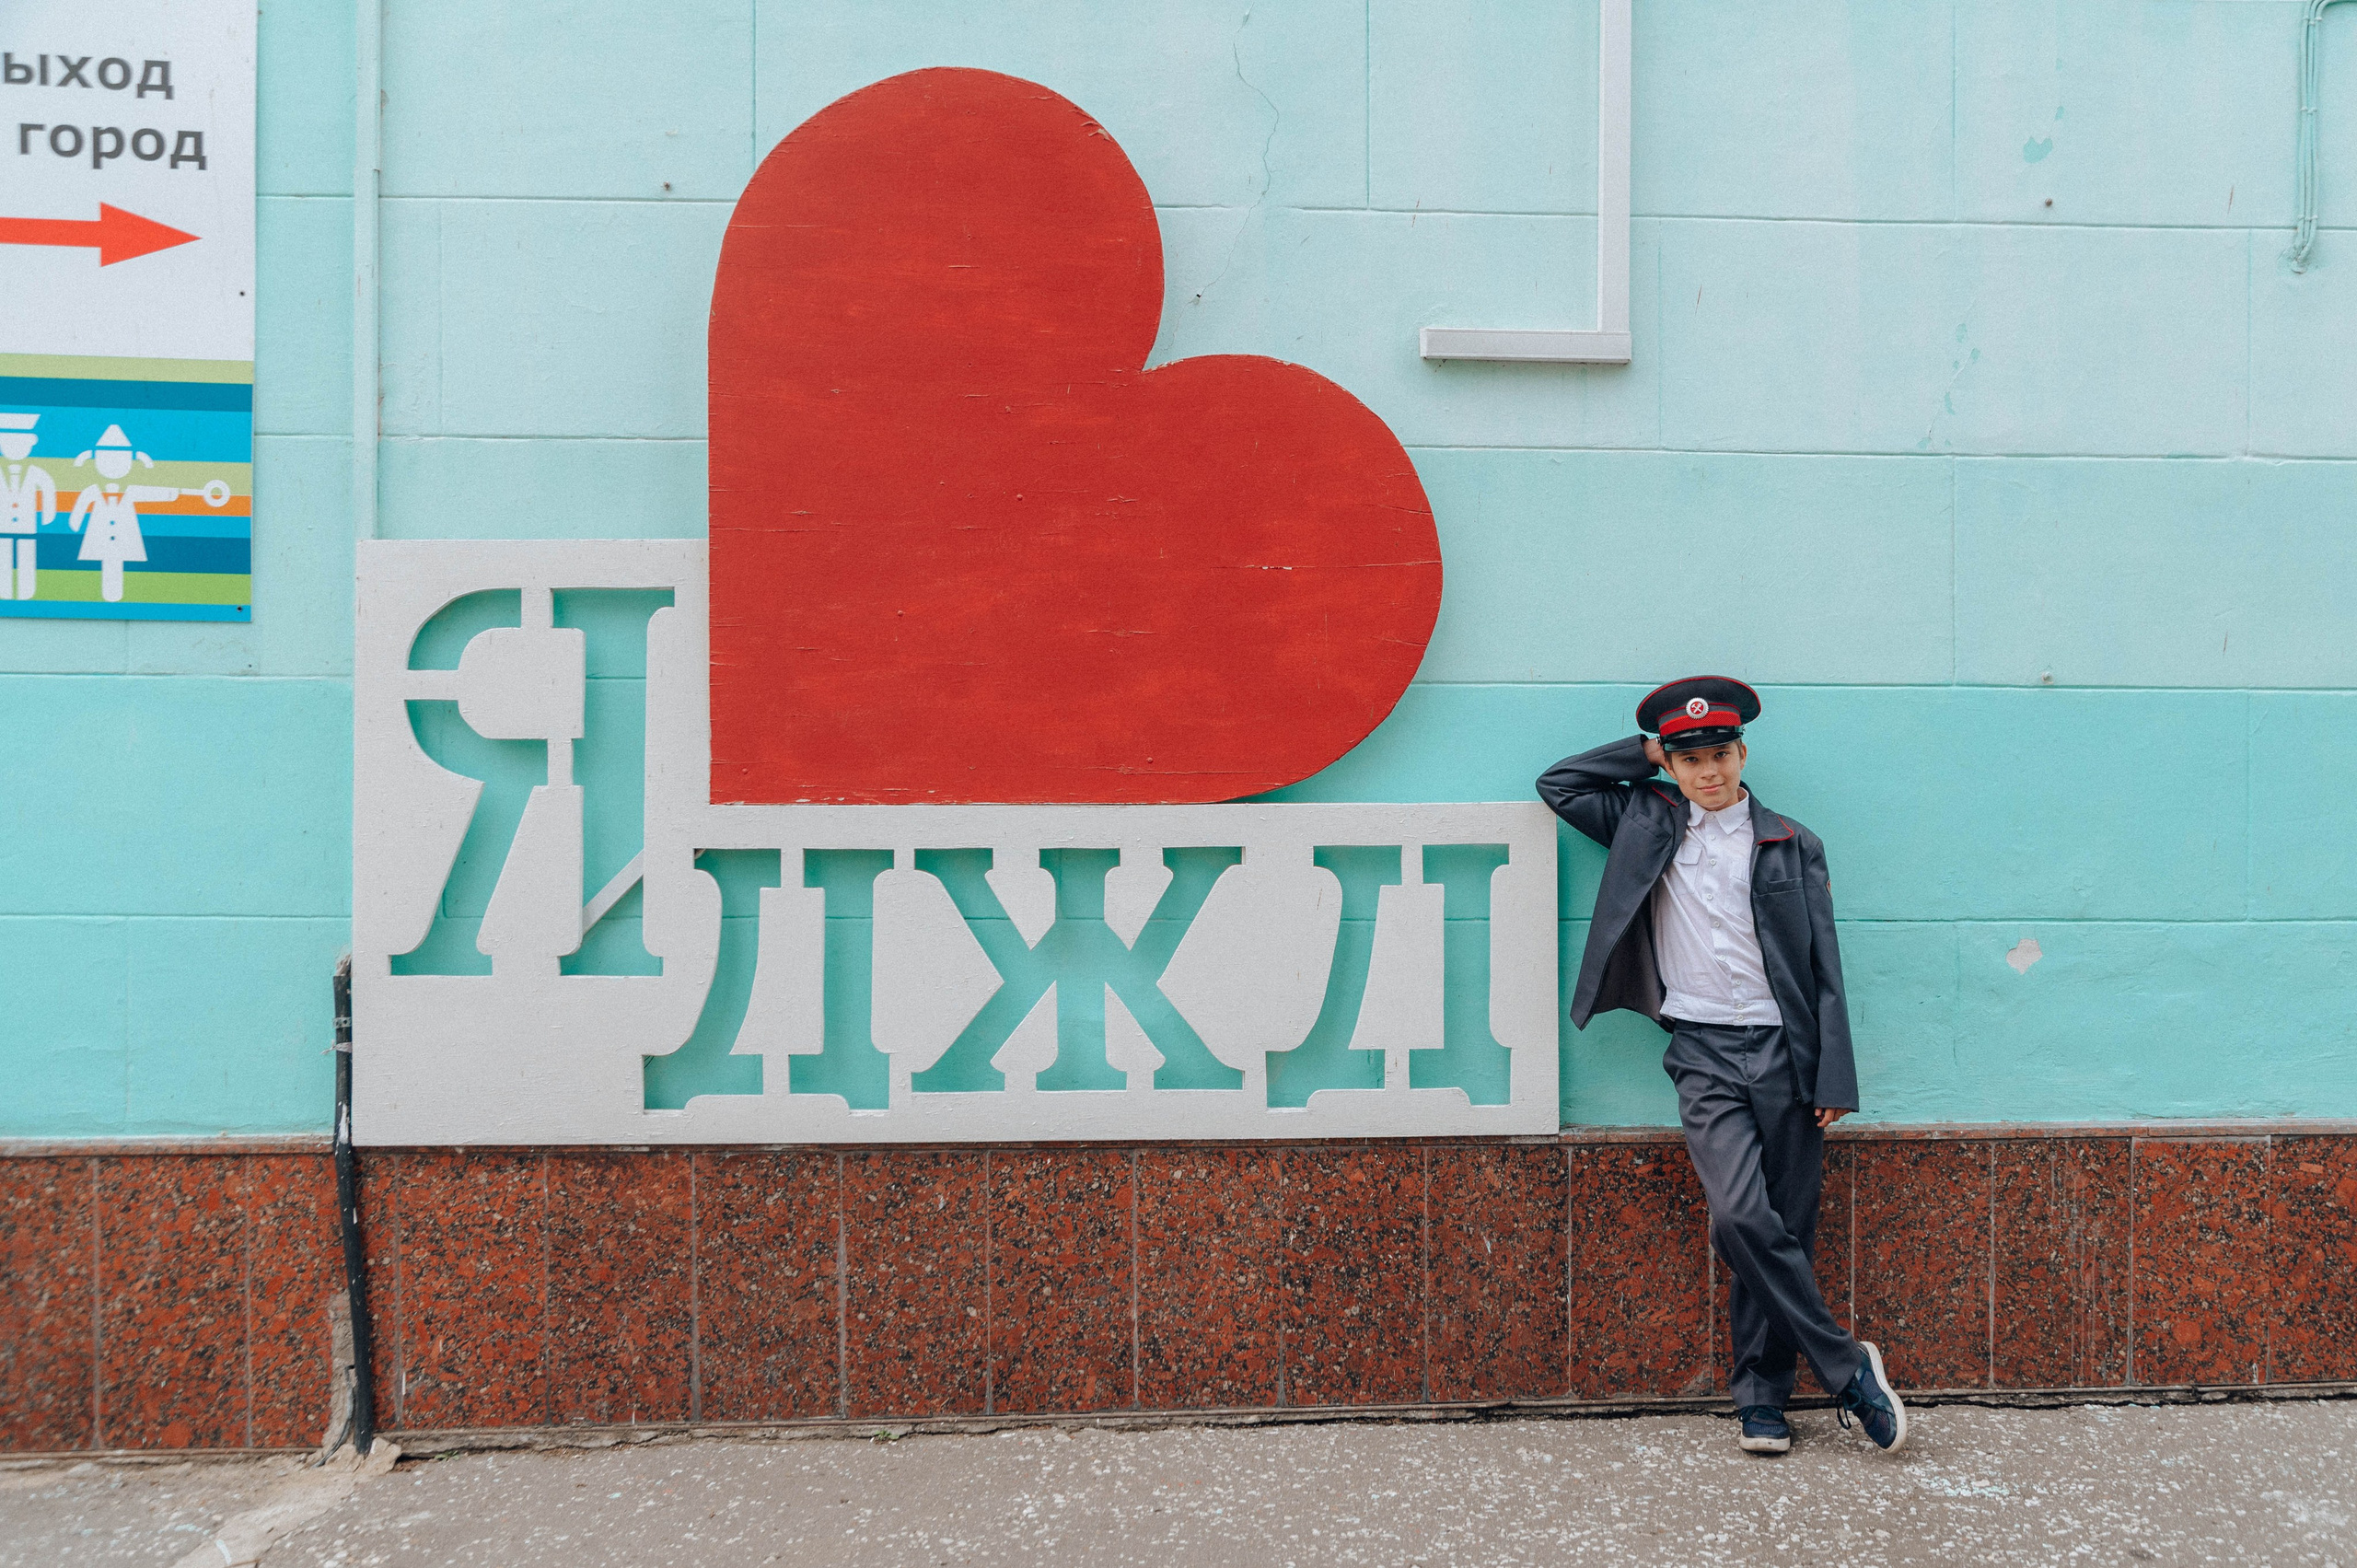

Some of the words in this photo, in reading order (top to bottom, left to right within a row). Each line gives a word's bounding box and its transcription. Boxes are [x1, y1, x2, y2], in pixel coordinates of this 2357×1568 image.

[3, 52, 174, 100] ыход
[18, 122, 208, 170] город
[390, 587, 676, 977] Я
[642, 843, 1513, 1112] ДЖД
